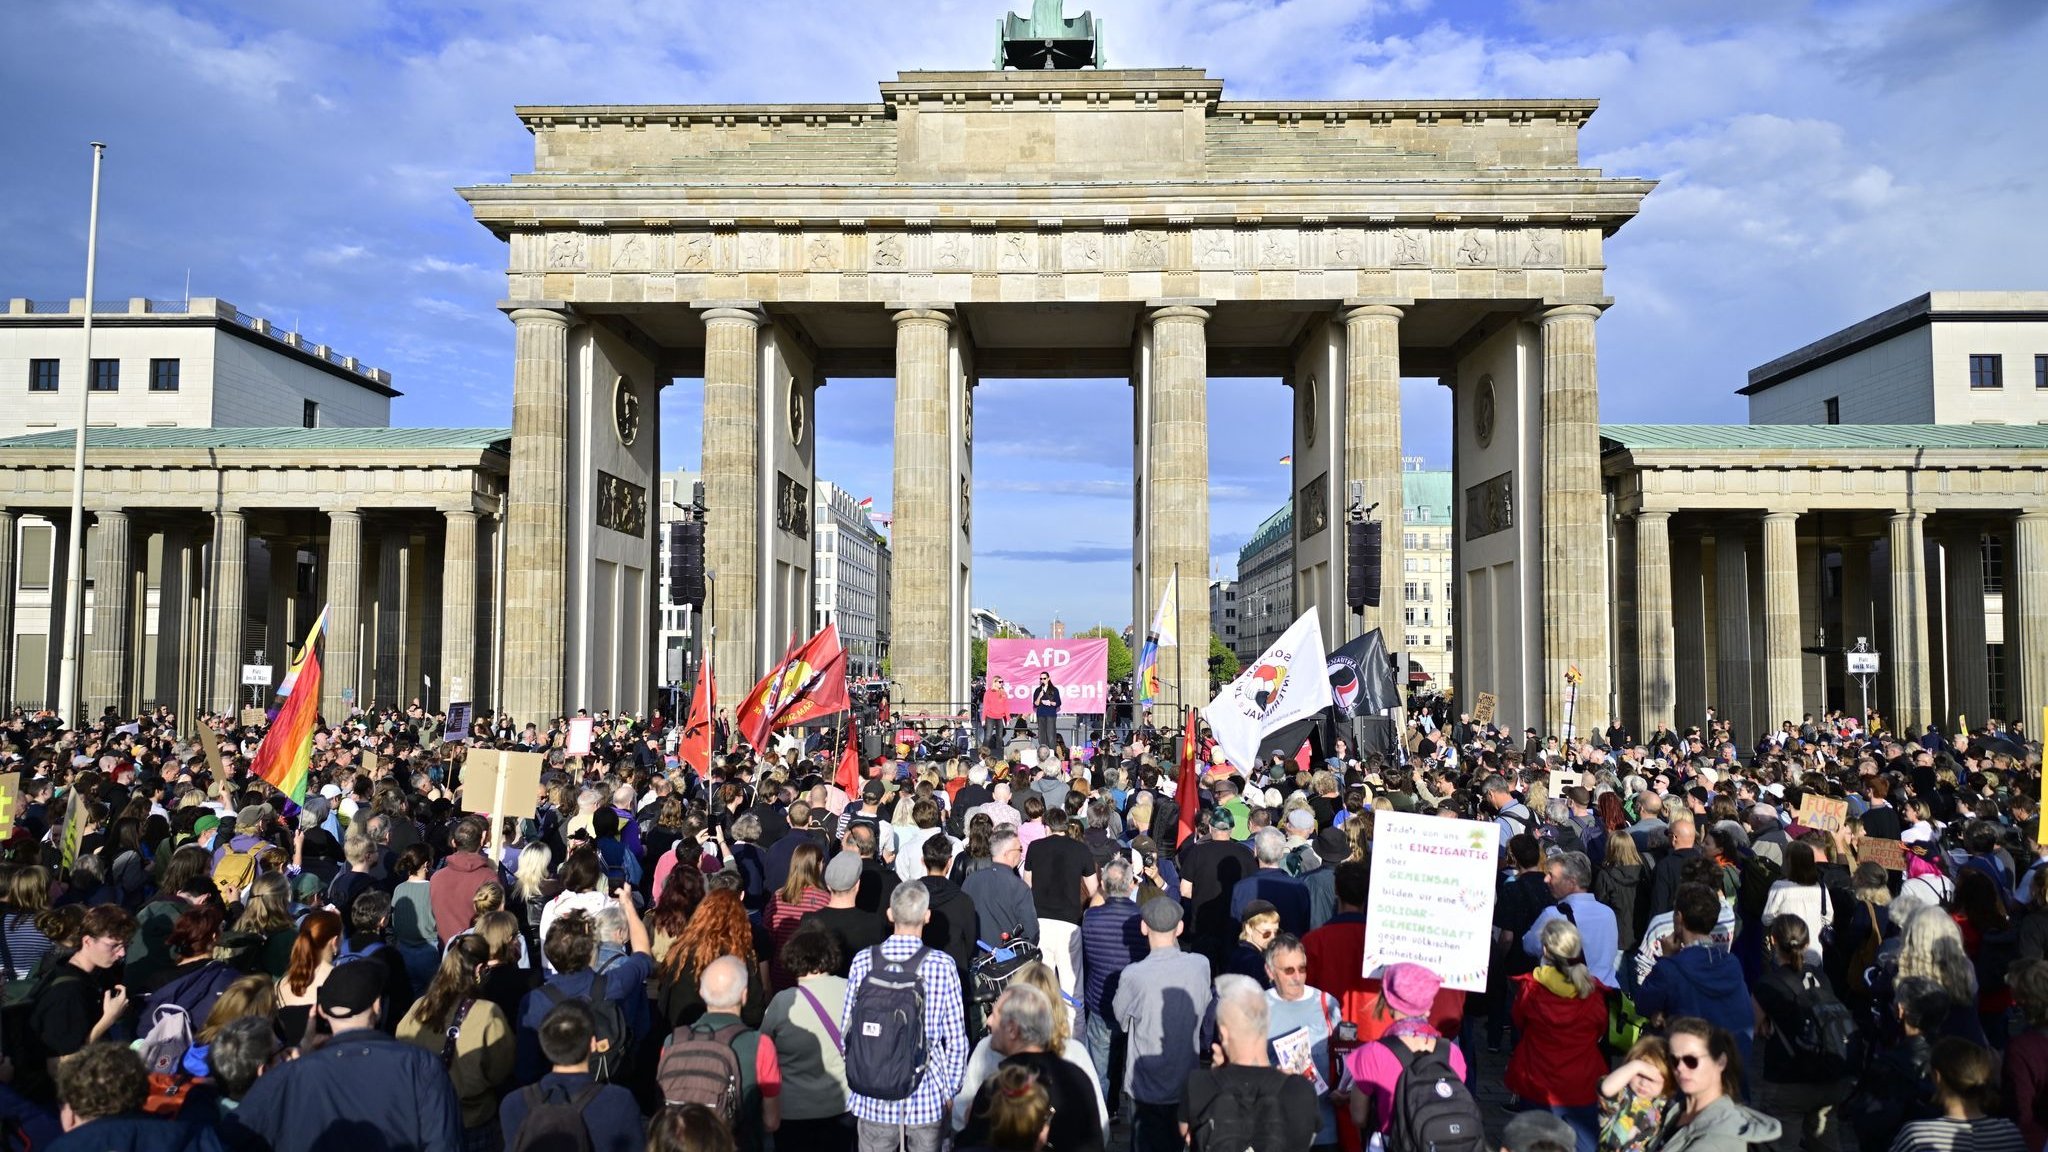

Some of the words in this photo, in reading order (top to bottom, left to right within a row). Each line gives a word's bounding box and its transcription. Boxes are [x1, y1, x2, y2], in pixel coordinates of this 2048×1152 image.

[1022, 648, 1070, 668] AfD
[1806, 798, 1844, 818] FUCK
[1422, 830, 1439, 838] von
[1443, 832, 1459, 840] uns
[1391, 842, 1403, 850] ist
[1409, 843, 1489, 860] EINZIGARTIG
[1385, 857, 1407, 866] aber
[1389, 871, 1460, 886] GEMEINSAM
[1382, 887, 1413, 898] bilden
[1437, 897, 1457, 905] eine
[1376, 904, 1435, 918] SOLIDAR-
[1381, 919, 1474, 940] GEMEINSCHAFT
[1378, 932, 1407, 945] gegen
